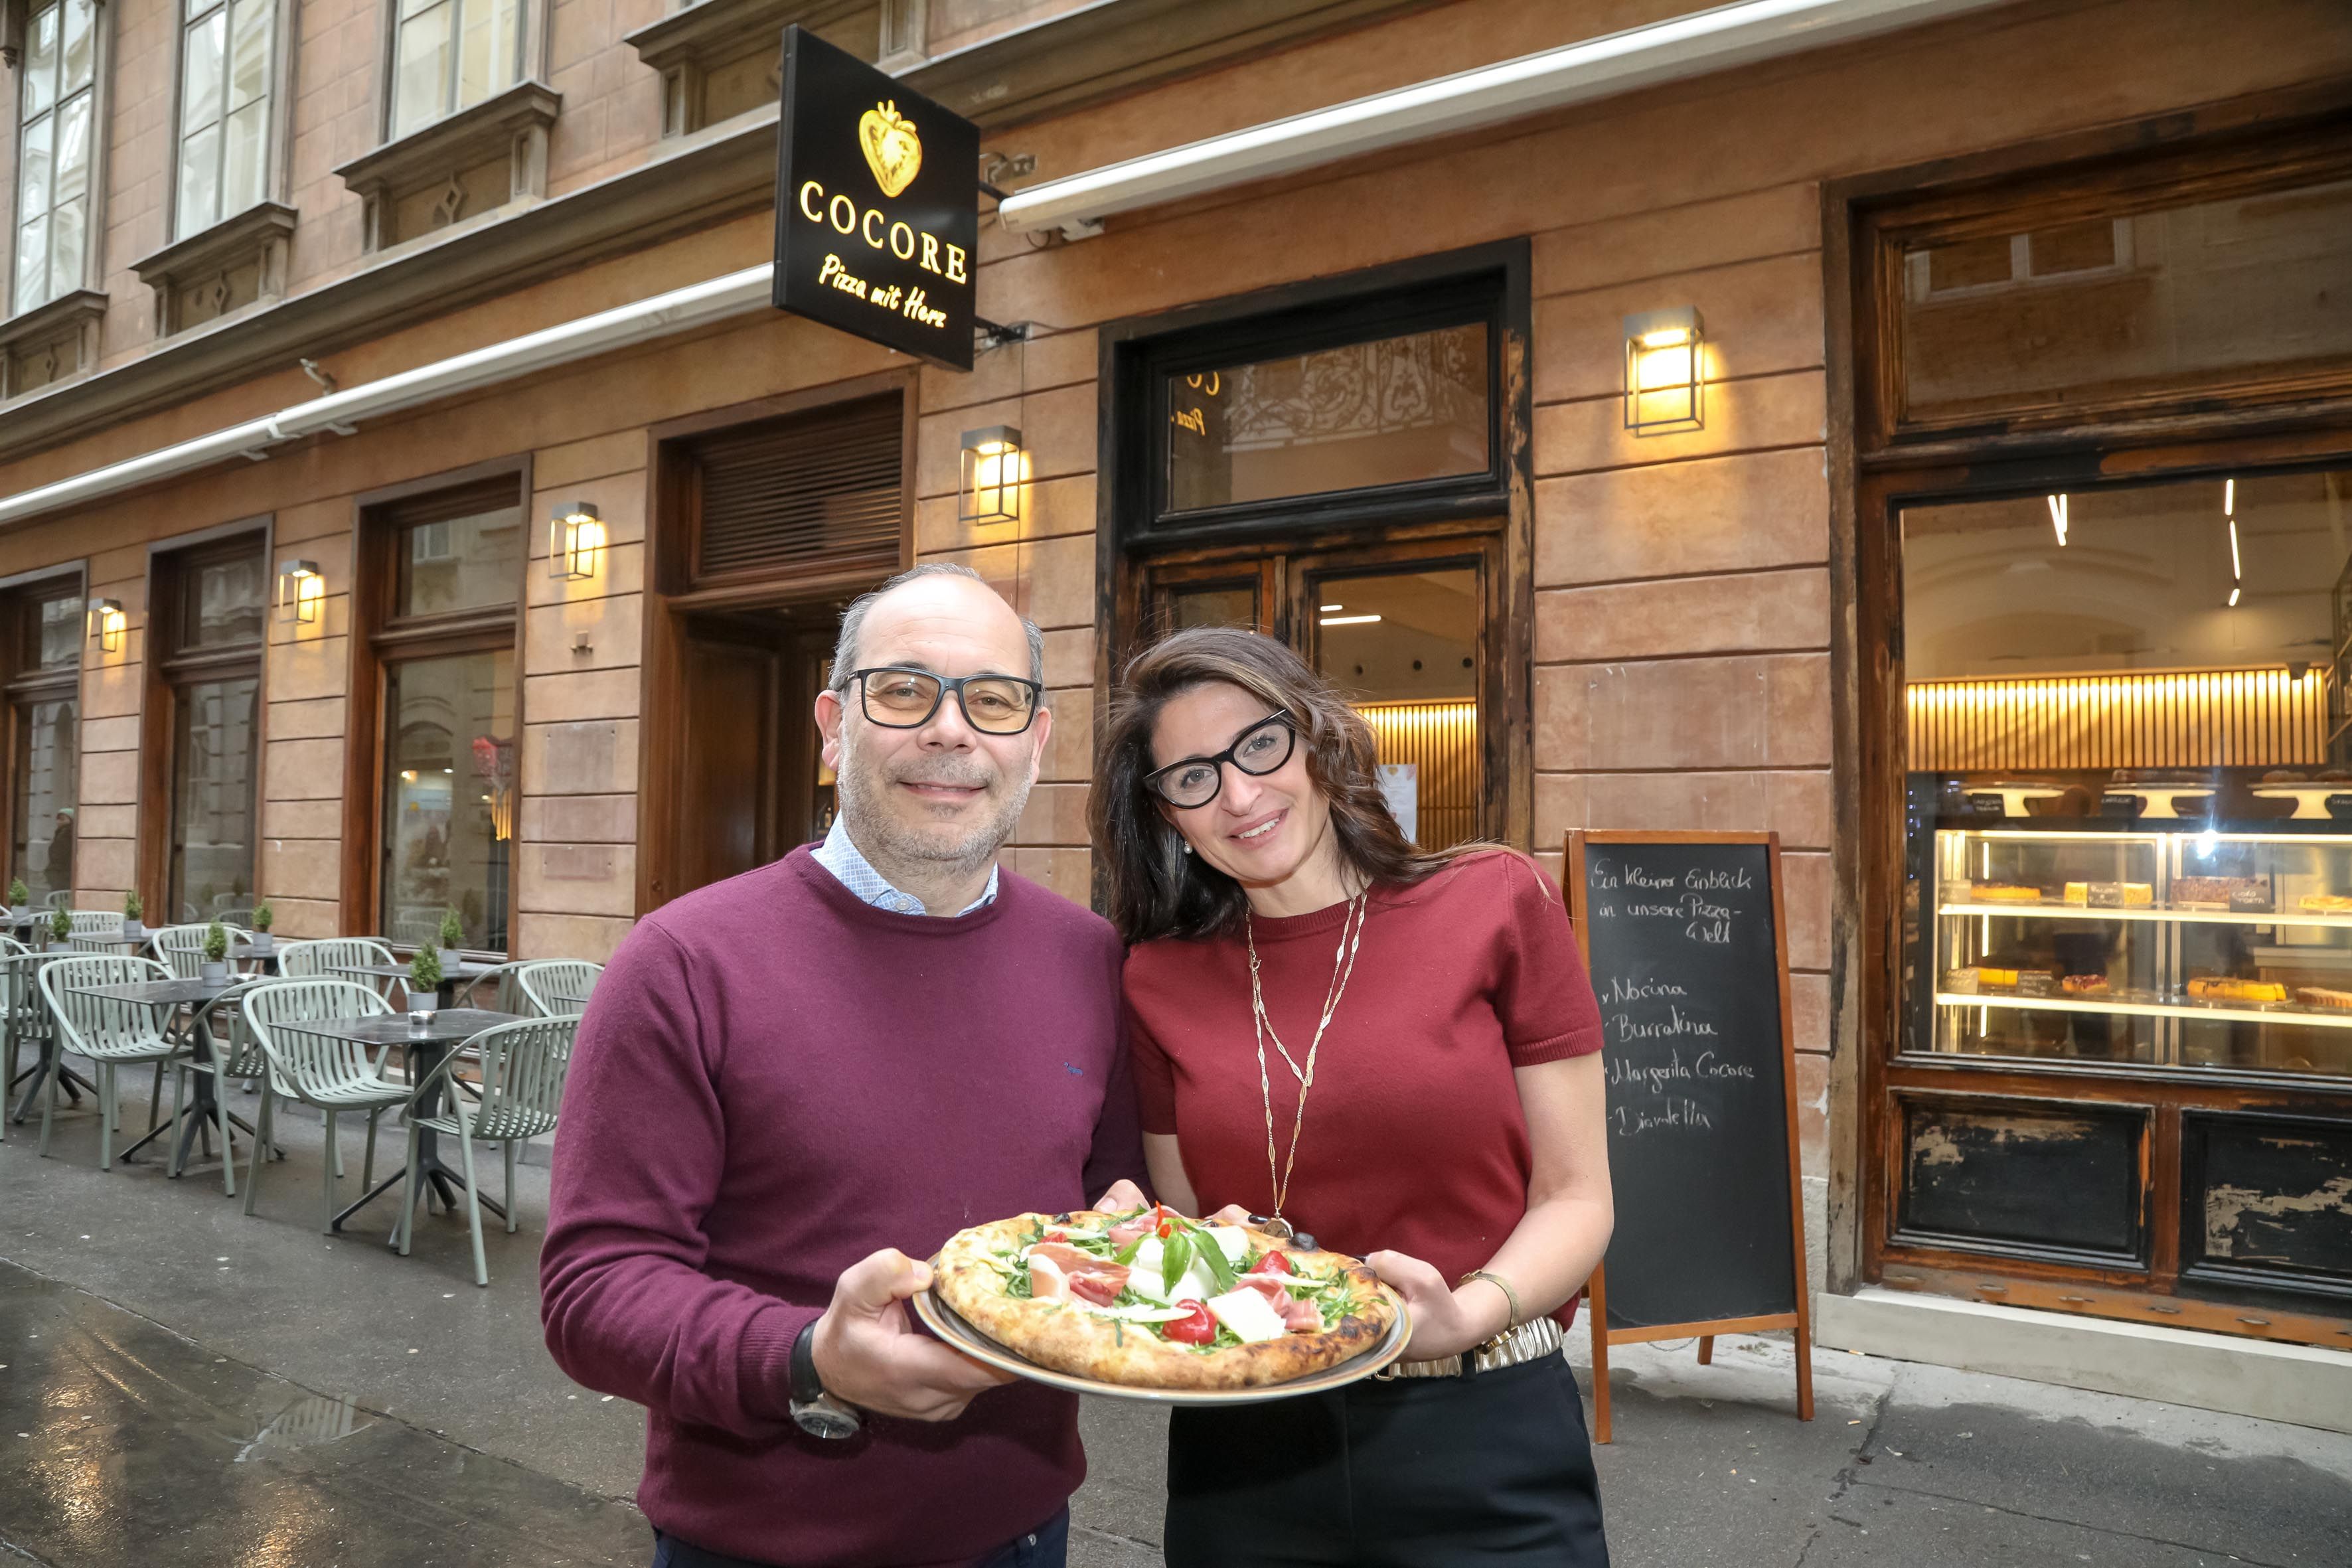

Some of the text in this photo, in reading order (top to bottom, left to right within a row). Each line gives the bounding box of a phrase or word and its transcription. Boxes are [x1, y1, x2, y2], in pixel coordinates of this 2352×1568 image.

[800, 181, 967, 284] COCORE
[819, 253, 947, 328] Pizza mit Herz
[1686, 868, 1752, 890] Einblick
[1627, 905, 1684, 918] unsere
